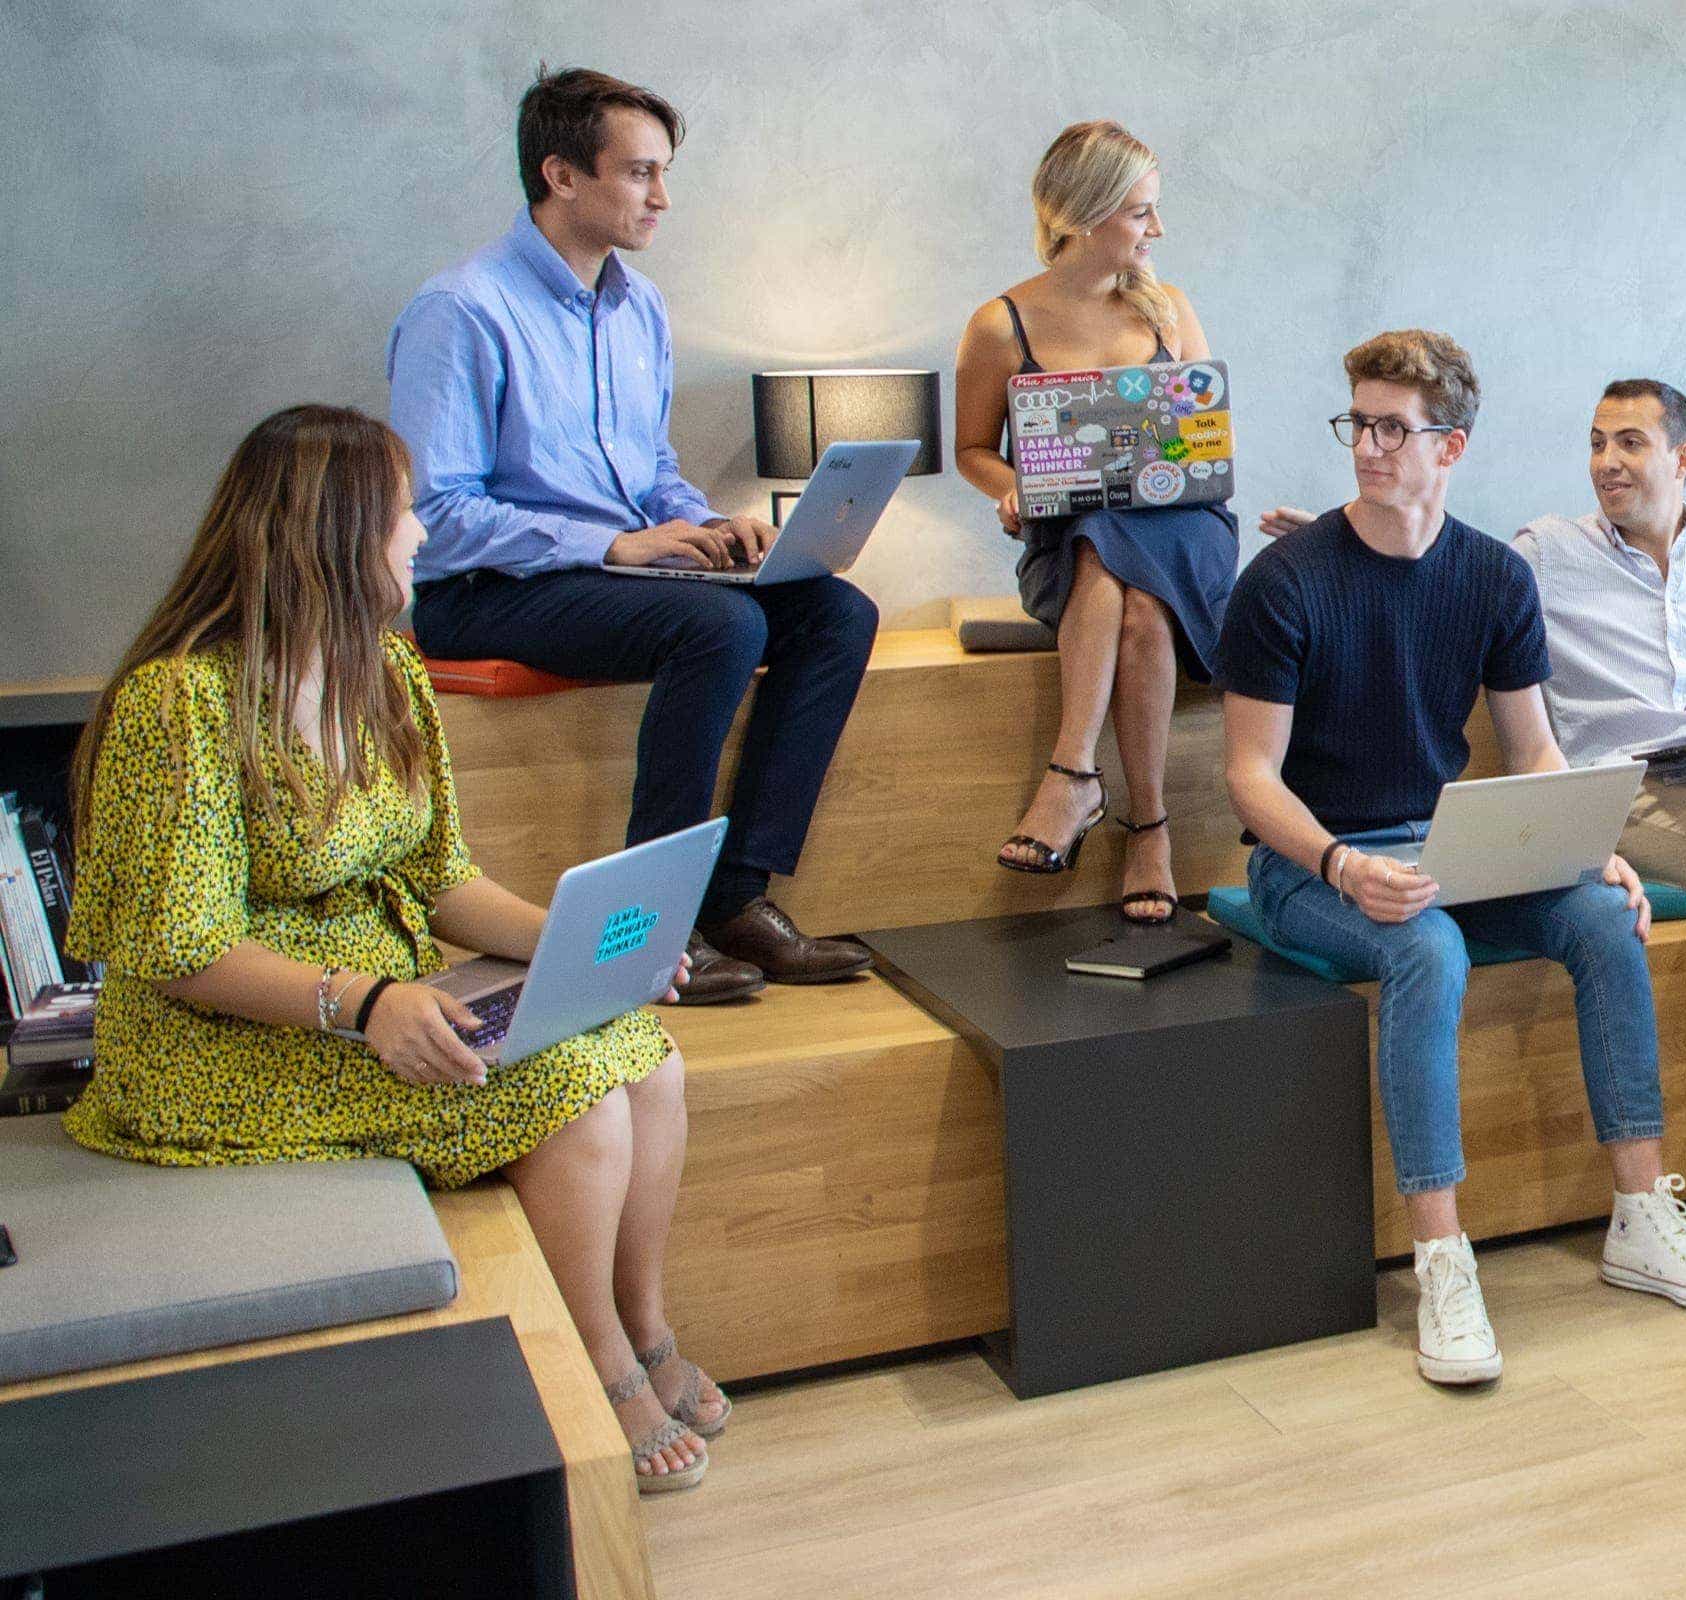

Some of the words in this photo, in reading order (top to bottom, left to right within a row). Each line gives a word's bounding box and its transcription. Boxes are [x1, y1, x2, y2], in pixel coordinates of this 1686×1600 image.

[1195, 418, 1217, 429] Talk
[1019, 439, 1024, 450] I
[1027, 438, 1050, 450] AM
[1053, 436, 1063, 448] A
[1206, 440, 1222, 448] me
[1021, 446, 1092, 462] FORWARD
[1021, 459, 1088, 475] THINKER.
[601, 913, 659, 946] FORWARD
